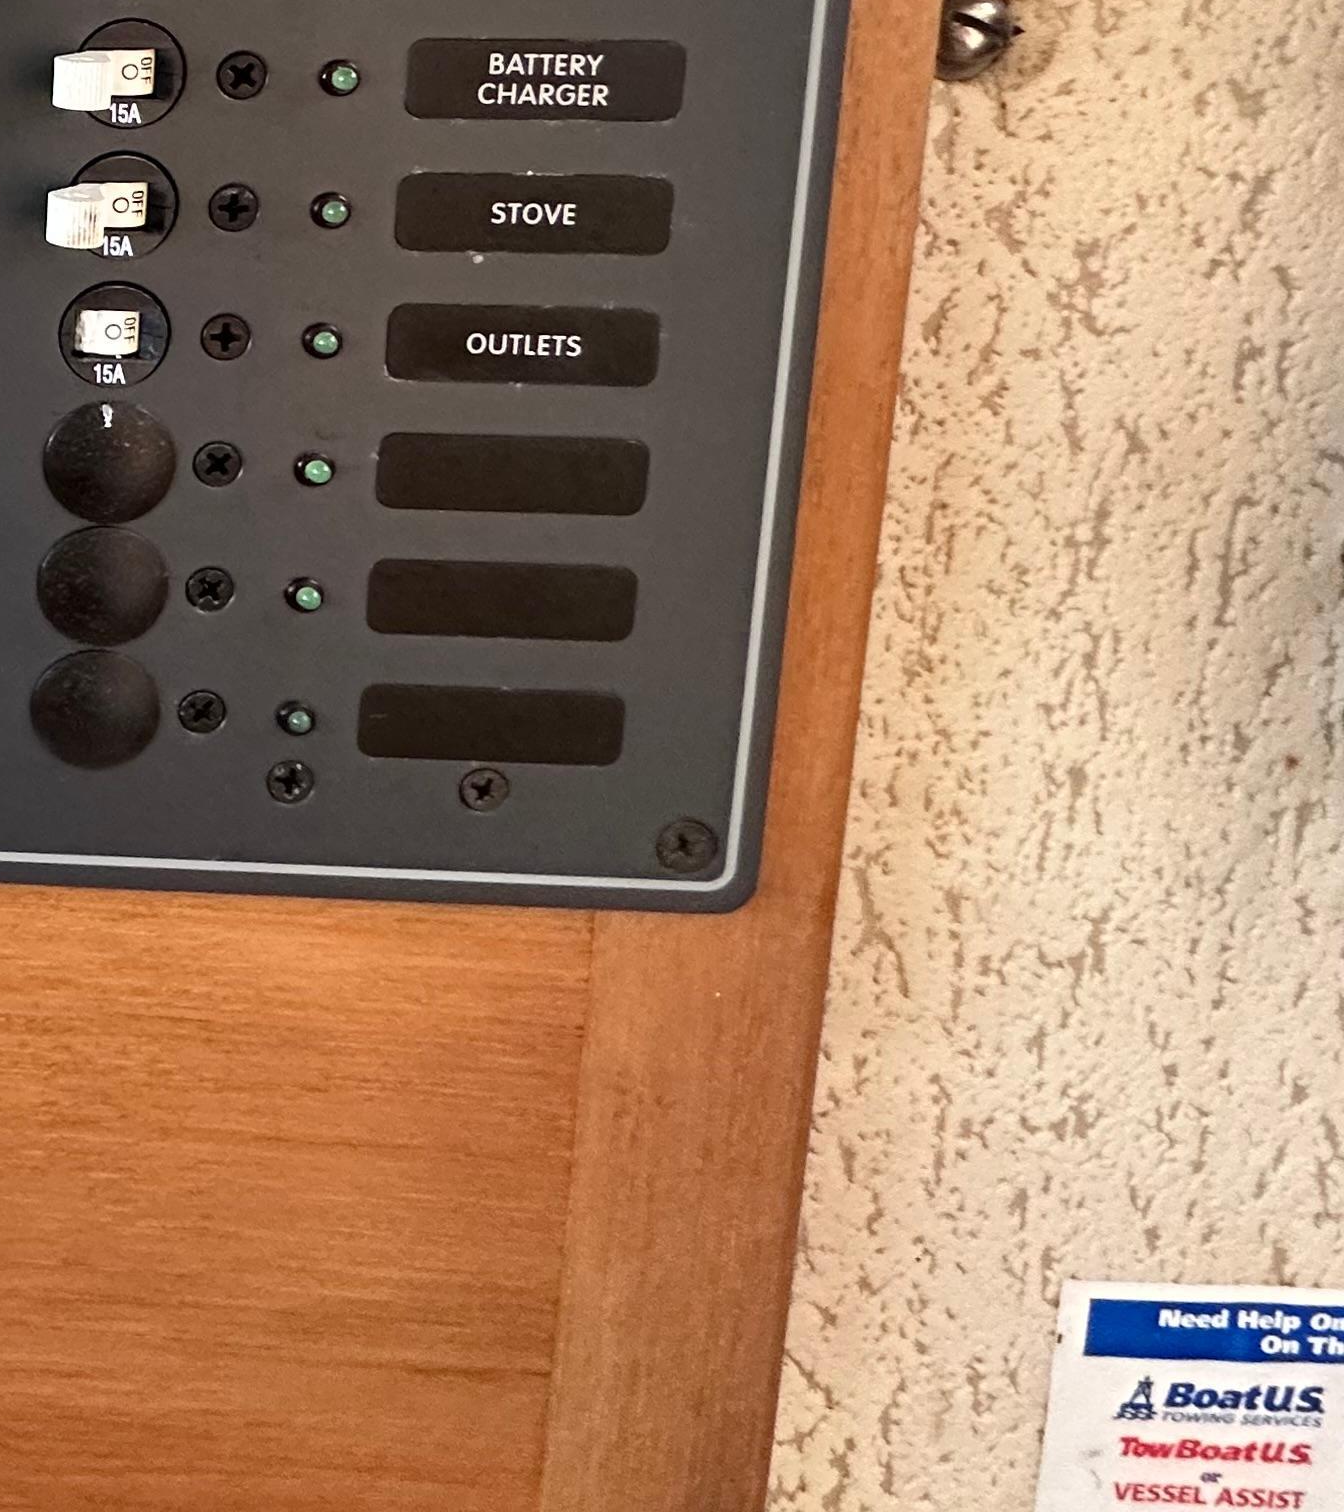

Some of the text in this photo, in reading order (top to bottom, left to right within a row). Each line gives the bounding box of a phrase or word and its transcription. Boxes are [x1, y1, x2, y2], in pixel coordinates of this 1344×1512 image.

[140, 58, 154, 87] OFF
[488, 53, 604, 77] BATTERY
[478, 83, 608, 107] CHARGER
[109, 103, 140, 124] 15A
[132, 190, 146, 219] OFF
[491, 203, 576, 226] STOVE
[102, 235, 133, 257] 15A
[123, 317, 137, 344] OFF
[466, 333, 582, 357] OUTLETS
[94, 364, 126, 384] 15A
[1159, 1309, 1228, 1328] Need
[1238, 1311, 1301, 1335] Help
[1261, 1336, 1299, 1354] On
[1164, 1383, 1324, 1413] BoatUS
[1162, 1413, 1323, 1427] TOWING SERVICES
[1120, 1437, 1312, 1465] TowBoatUS
[1201, 1472, 1222, 1483] or
[1115, 1482, 1305, 1509] VESSEL ASSIST
